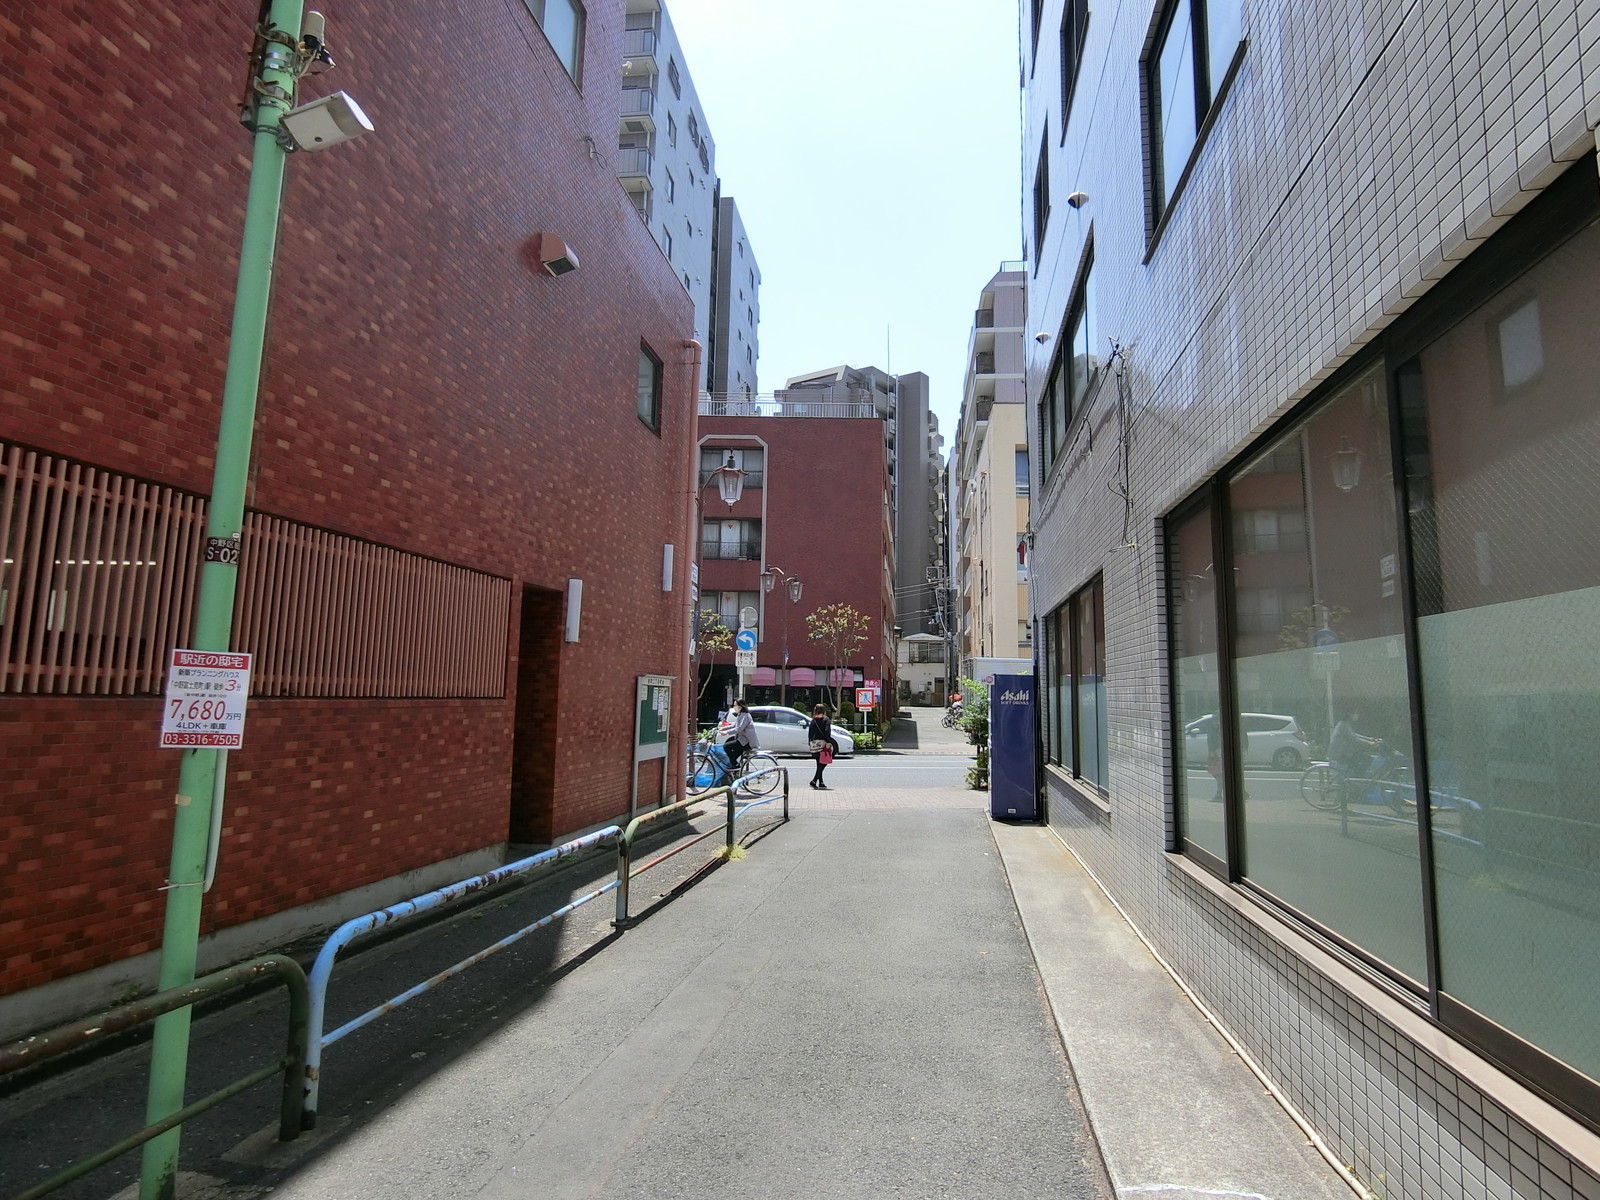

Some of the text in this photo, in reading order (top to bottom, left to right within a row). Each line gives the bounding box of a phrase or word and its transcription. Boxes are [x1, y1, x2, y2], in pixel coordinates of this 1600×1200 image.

[180, 653, 244, 668] 駅近の邸宅
[1000, 690, 1029, 701] Asahi
[164, 734, 238, 745] 03-3316-7505
